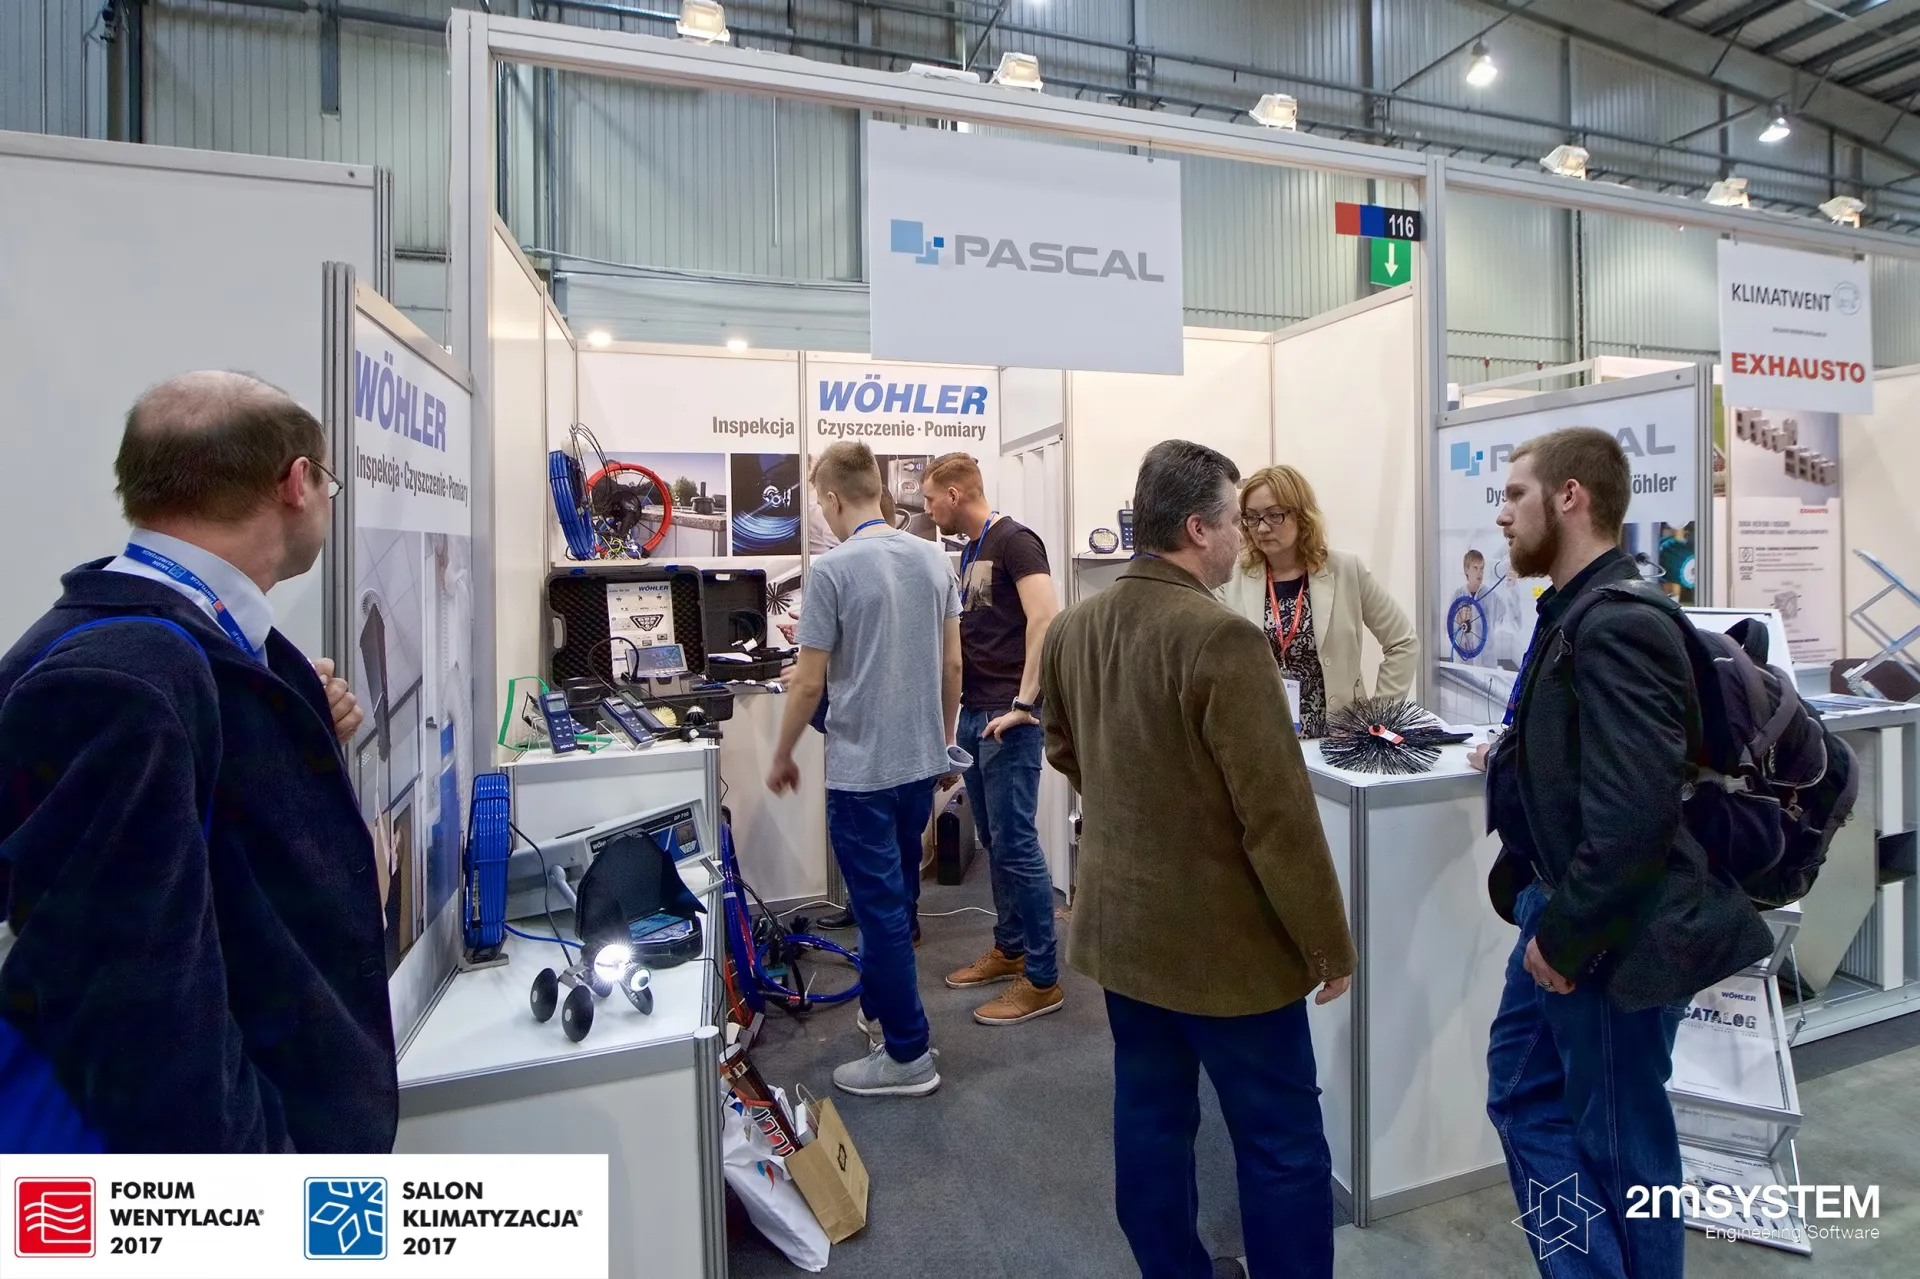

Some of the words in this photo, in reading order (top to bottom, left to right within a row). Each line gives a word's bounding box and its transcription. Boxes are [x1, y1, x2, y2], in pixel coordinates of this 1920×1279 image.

[1388, 214, 1414, 238] 116
[954, 235, 1165, 282] PASCAL
[1731, 282, 1831, 312] KLIMATWENT
[1731, 352, 1865, 383] EXHAUSTO
[355, 350, 446, 452] WÖHLER
[819, 373, 988, 415] WÖHLER
[712, 416, 795, 439] Inspekcja
[816, 418, 915, 438] Czyszczenie
[924, 421, 986, 441] Pomiary
[1490, 424, 1676, 472] PAL
[356, 446, 400, 492] Inspekcja
[404, 461, 446, 497] Czyszczenie
[448, 475, 468, 508] Pomiary
[1631, 475, 1677, 495] öhler
[1721, 991, 1756, 1002] WÖHLER
[1684, 1006, 1757, 1030] CATALOG
